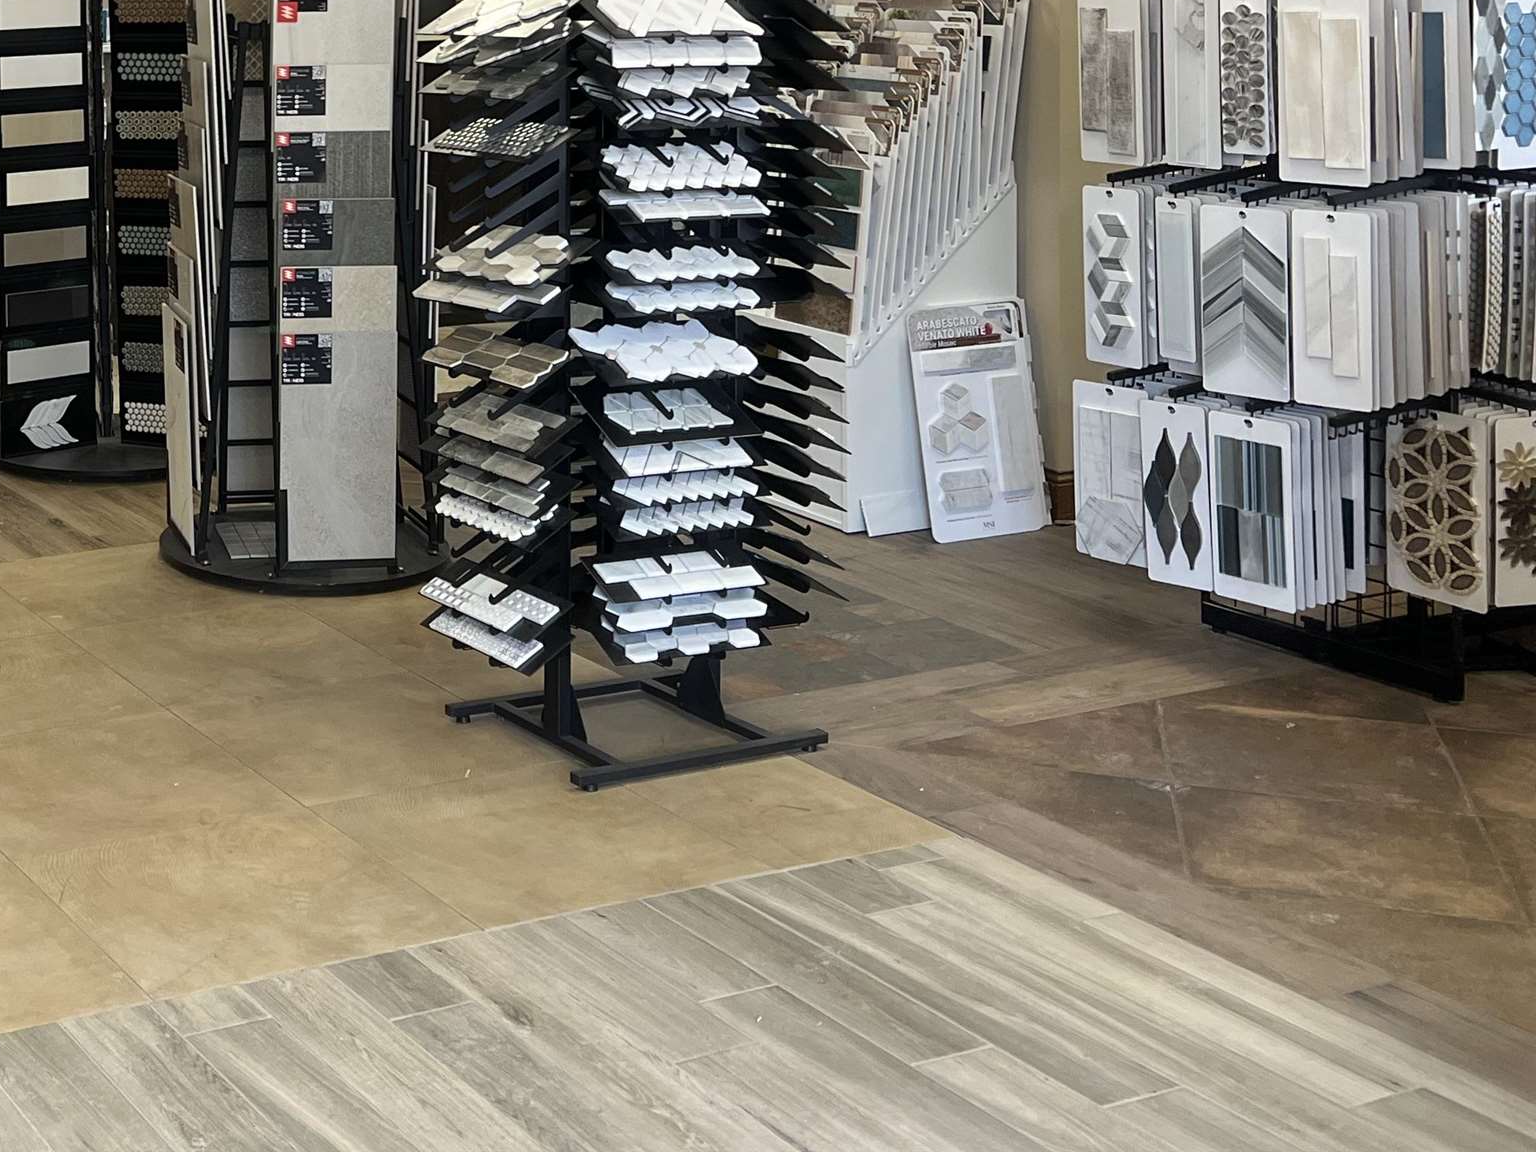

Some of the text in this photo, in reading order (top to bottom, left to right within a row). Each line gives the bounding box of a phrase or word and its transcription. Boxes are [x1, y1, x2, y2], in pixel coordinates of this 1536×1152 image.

[917, 315, 978, 330] ARABESCATO
[918, 326, 987, 341] VENATO WHITE
